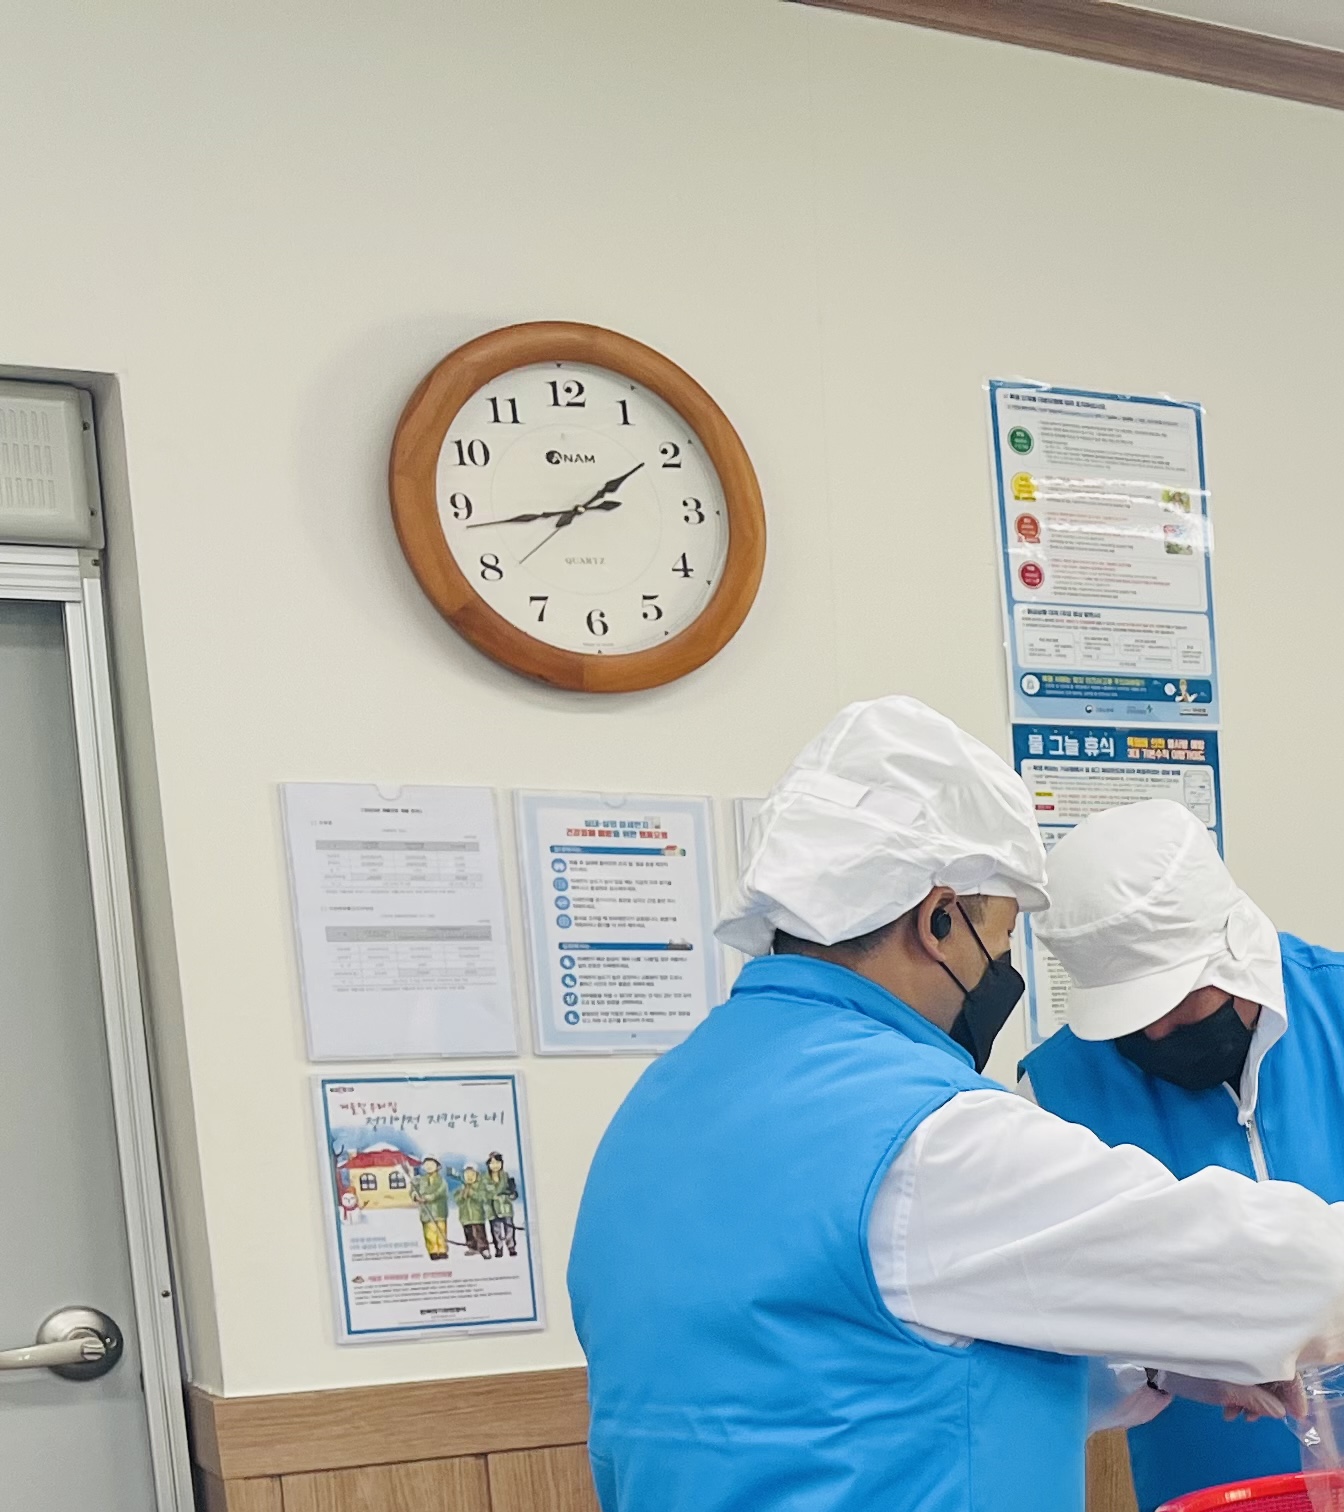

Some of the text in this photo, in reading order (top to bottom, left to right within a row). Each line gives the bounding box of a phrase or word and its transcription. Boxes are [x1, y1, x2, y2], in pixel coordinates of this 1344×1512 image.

[547, 380, 586, 408] 12
[486, 397, 524, 424] 11
[616, 399, 635, 426] 1
[451, 439, 490, 466] 10
[659, 442, 682, 469] 2
[450, 493, 473, 520] 9
[682, 497, 705, 525] 3
[480, 553, 504, 582] 8
[671, 552, 694, 579] 4
[529, 595, 549, 622] 7
[642, 595, 663, 621] 5
[586, 610, 609, 637] 6
